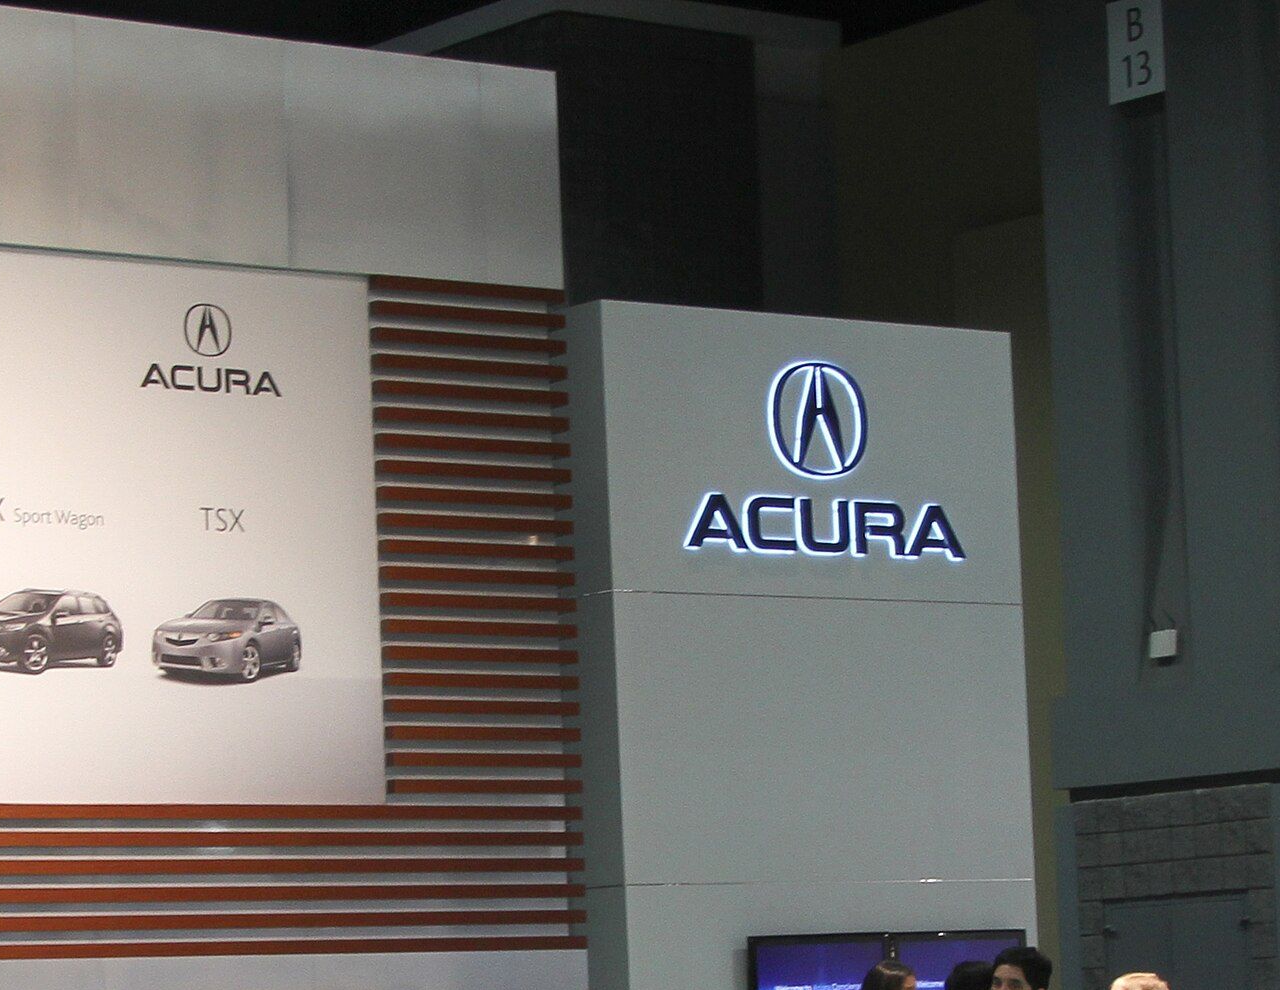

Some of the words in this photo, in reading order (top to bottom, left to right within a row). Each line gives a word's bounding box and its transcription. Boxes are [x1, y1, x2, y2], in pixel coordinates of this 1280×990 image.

[1126, 7, 1144, 42] B
[1121, 50, 1153, 88] 13
[140, 363, 282, 398] ACURA
[12, 507, 53, 527] Sport
[55, 509, 105, 531] Wagon
[199, 506, 246, 534] TSX
[684, 492, 966, 561] ACURA
